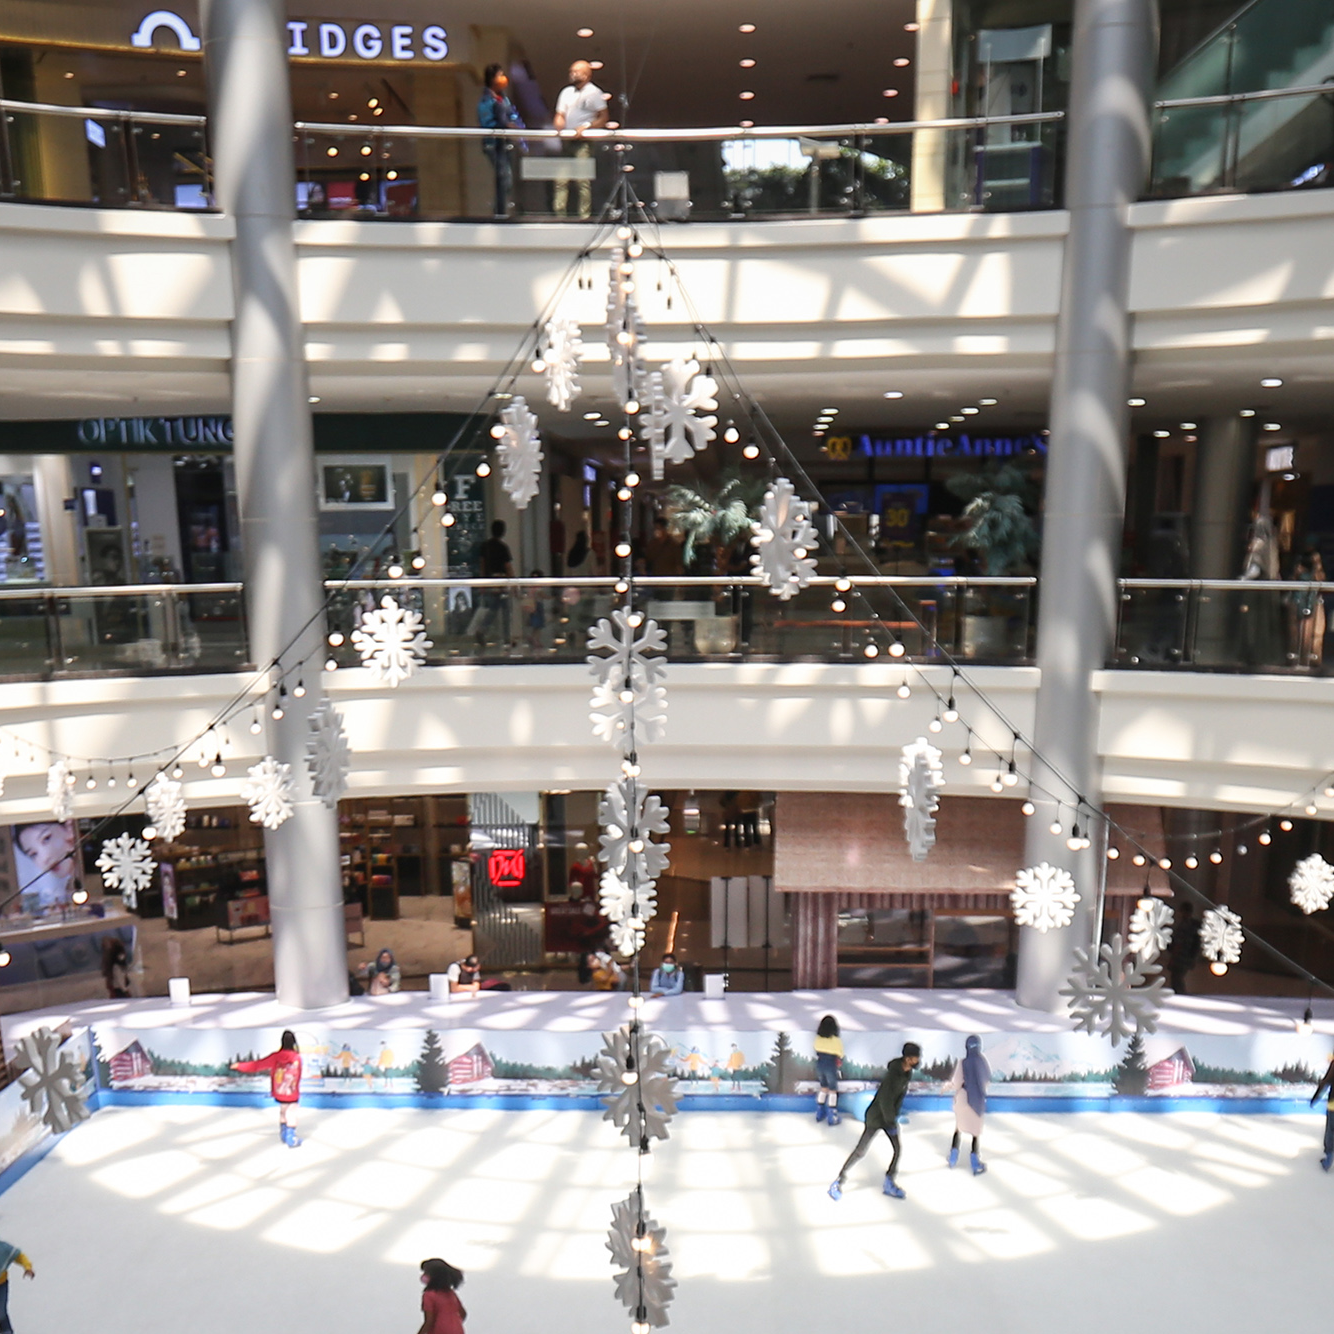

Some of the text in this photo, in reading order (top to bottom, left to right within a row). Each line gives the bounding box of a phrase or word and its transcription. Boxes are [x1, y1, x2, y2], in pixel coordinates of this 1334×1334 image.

[287, 20, 448, 61] IDGES
[77, 418, 158, 445] OPTIK
[857, 433, 953, 457] Auntie
